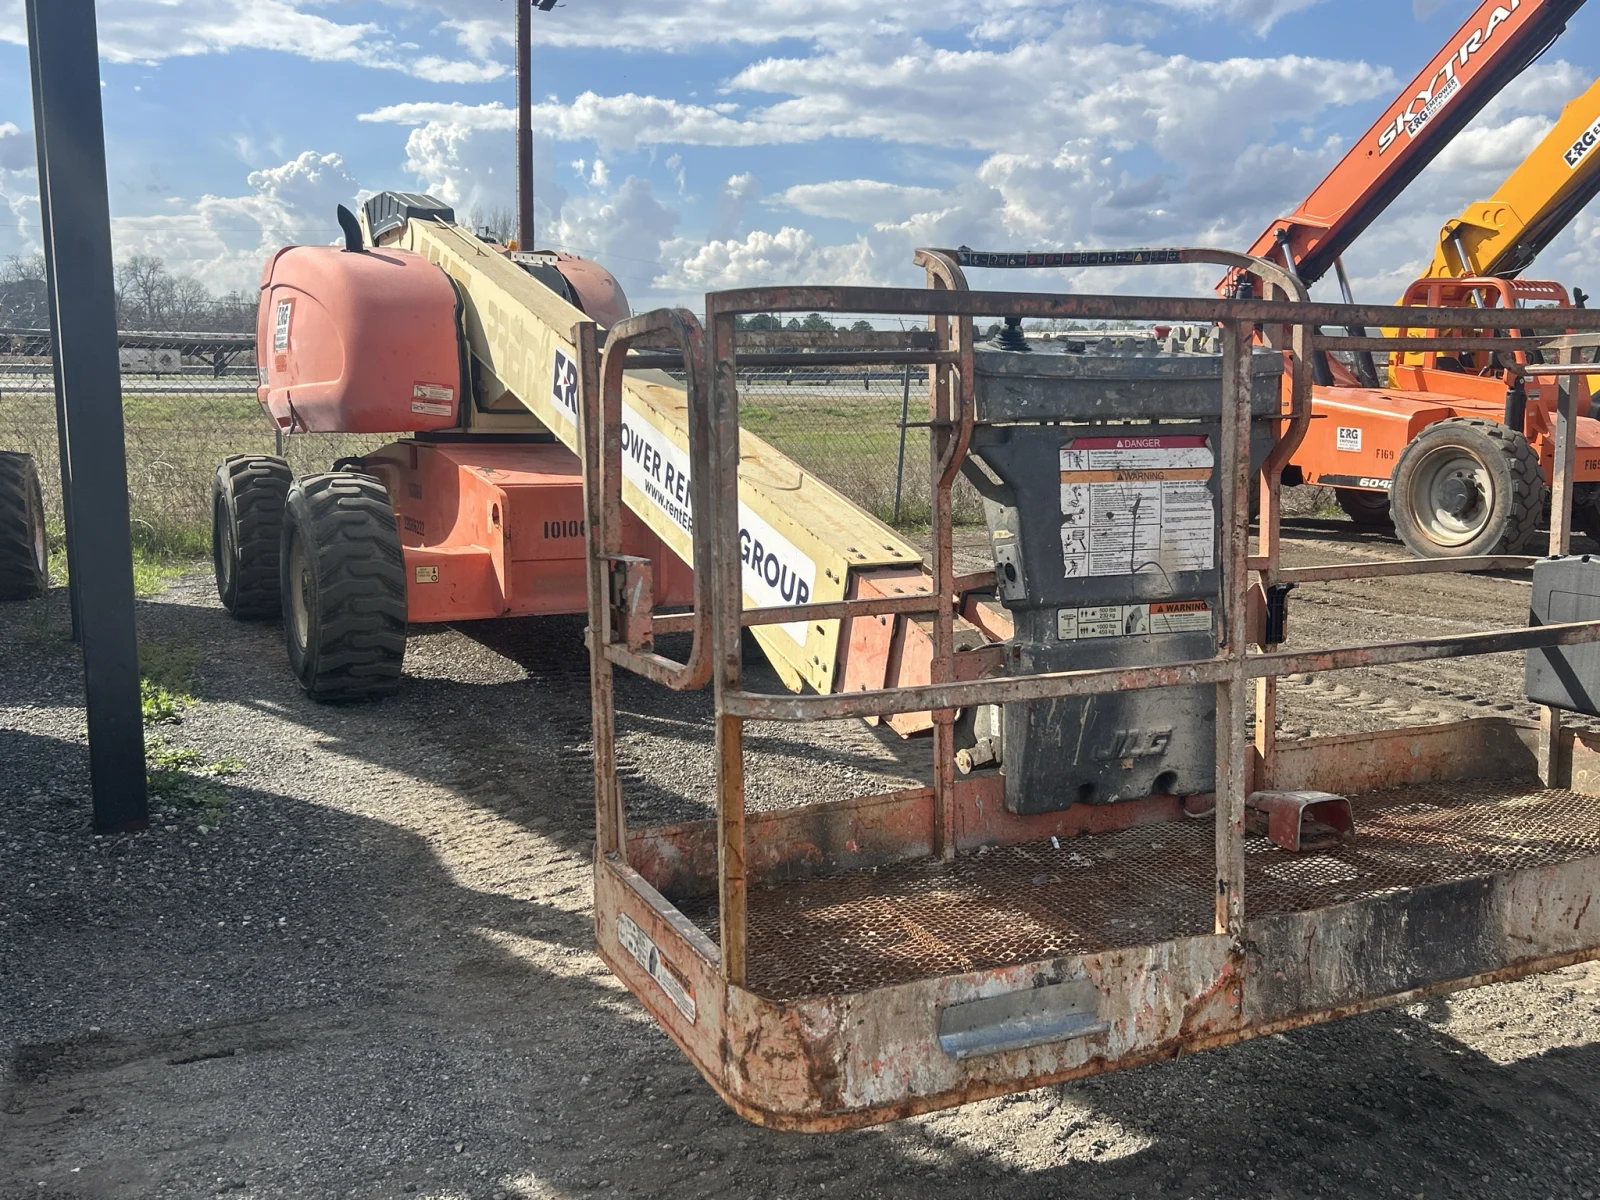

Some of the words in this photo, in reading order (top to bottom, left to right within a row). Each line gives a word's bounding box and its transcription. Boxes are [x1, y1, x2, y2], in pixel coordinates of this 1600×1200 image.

[1378, 0, 1521, 156] SKYTRA
[1408, 110, 1428, 134] ERG
[1426, 79, 1456, 111] EMPOWER
[1564, 131, 1597, 166] ERG
[1124, 438, 1161, 448] DANGER
[1339, 428, 1358, 439] ERG
[1376, 448, 1394, 460] F169
[1124, 471, 1165, 481] WARNING
[738, 527, 810, 605] GROUP
[1166, 602, 1207, 613] WARNING
[1092, 726, 1172, 760] JLG
